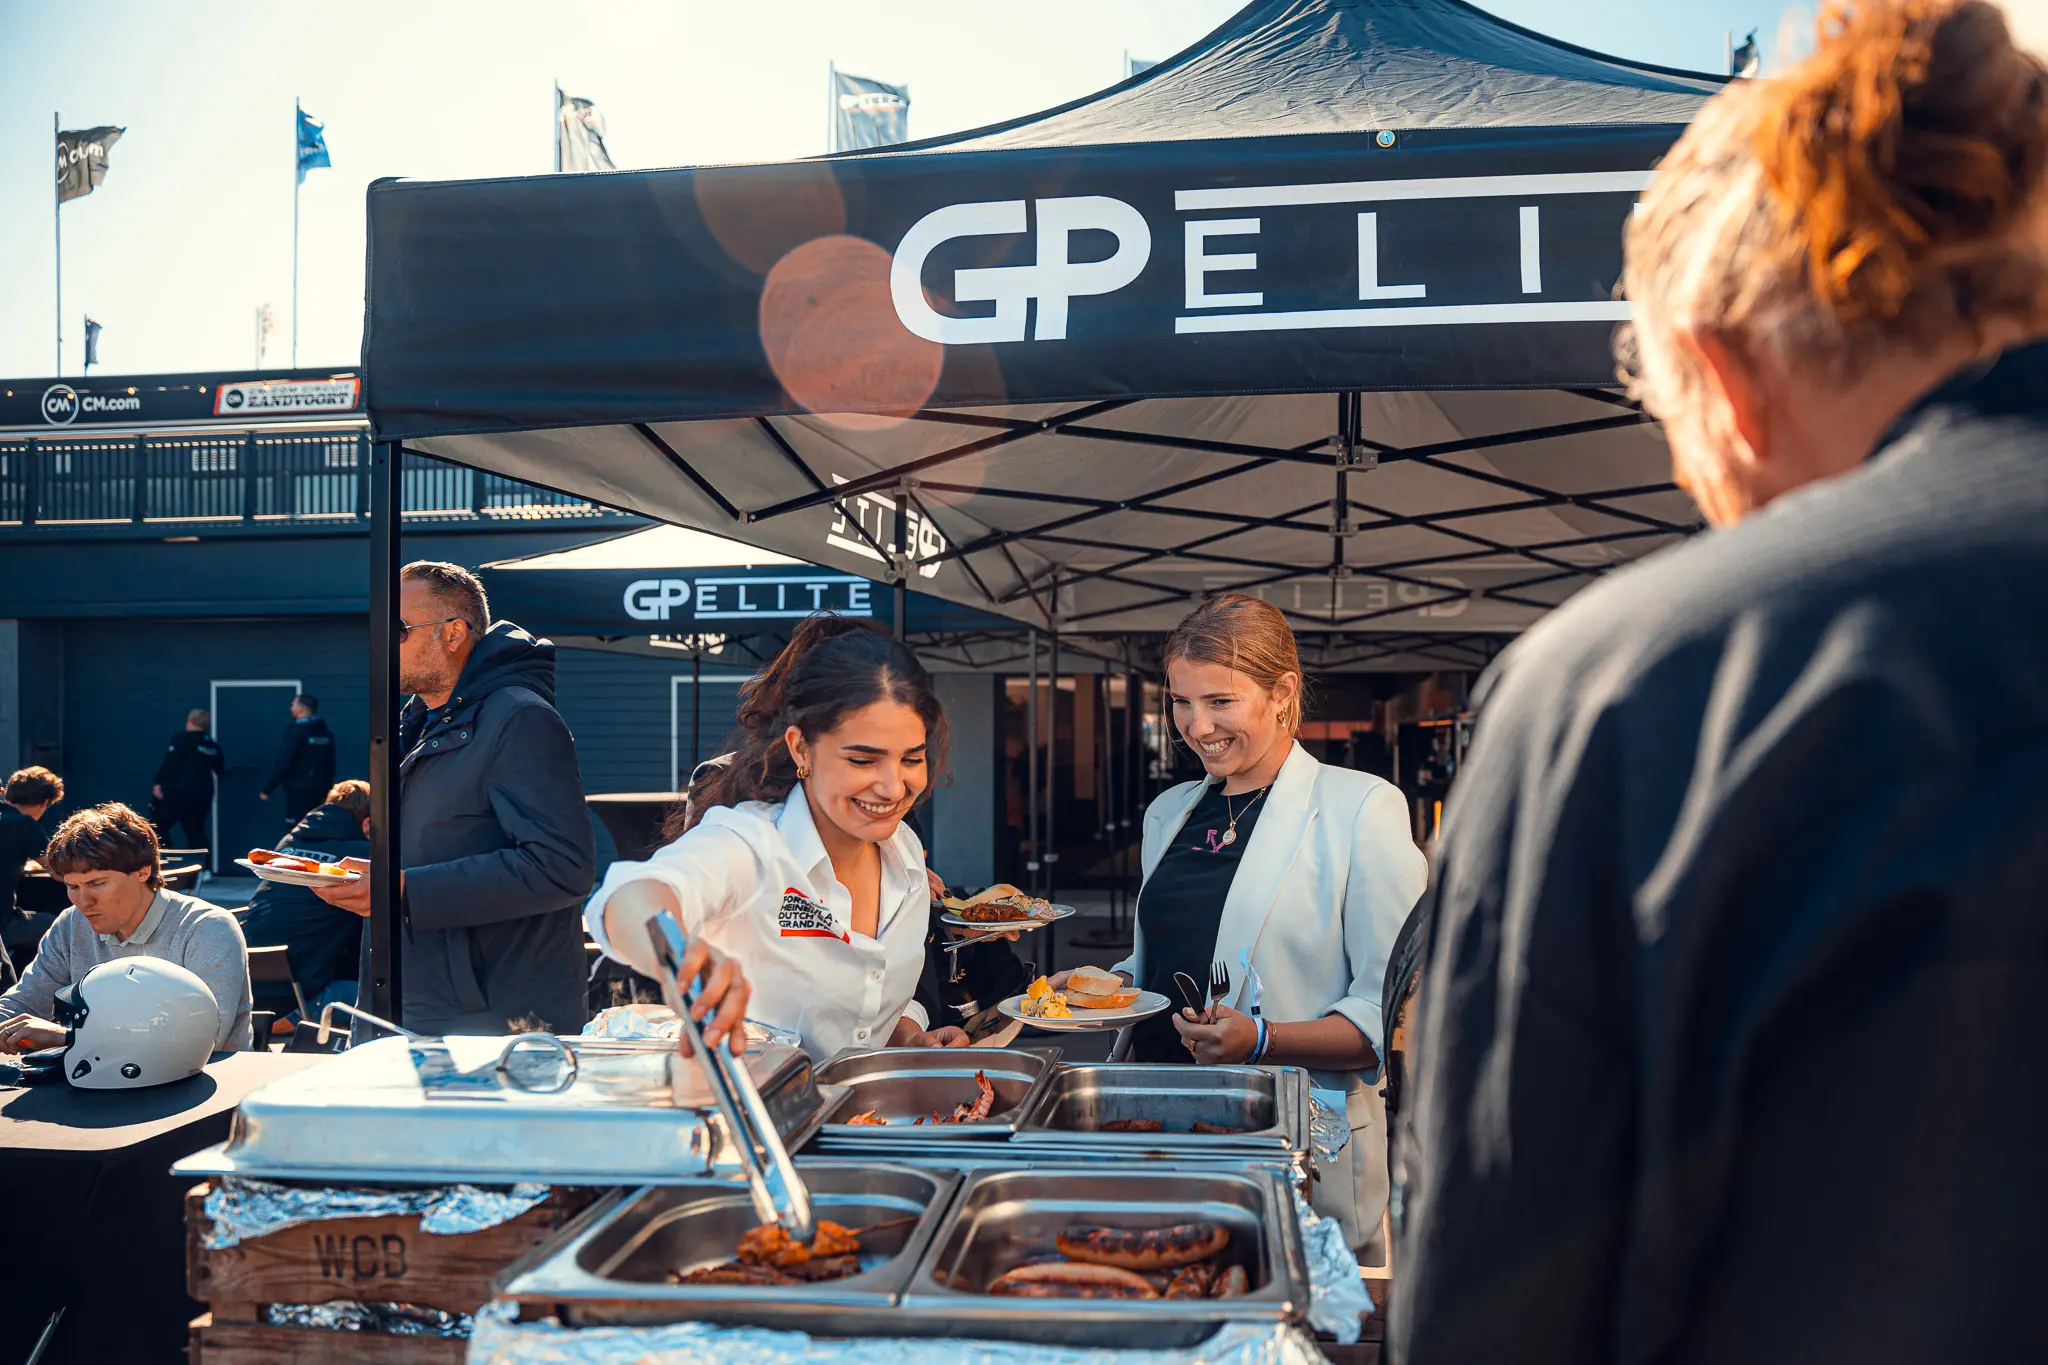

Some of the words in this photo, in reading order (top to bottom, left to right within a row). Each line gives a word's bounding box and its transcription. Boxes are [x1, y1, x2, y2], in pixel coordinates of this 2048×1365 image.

[890, 195, 1151, 345] GP
[1184, 202, 1645, 311] ELI
[82, 396, 141, 412] CM.com
[248, 393, 349, 408] ZANDVOORT
[623, 578, 691, 621] GP
[696, 583, 872, 612] ELITE
[778, 920, 815, 928] GRAND
[313, 1233, 408, 1278] WCB
